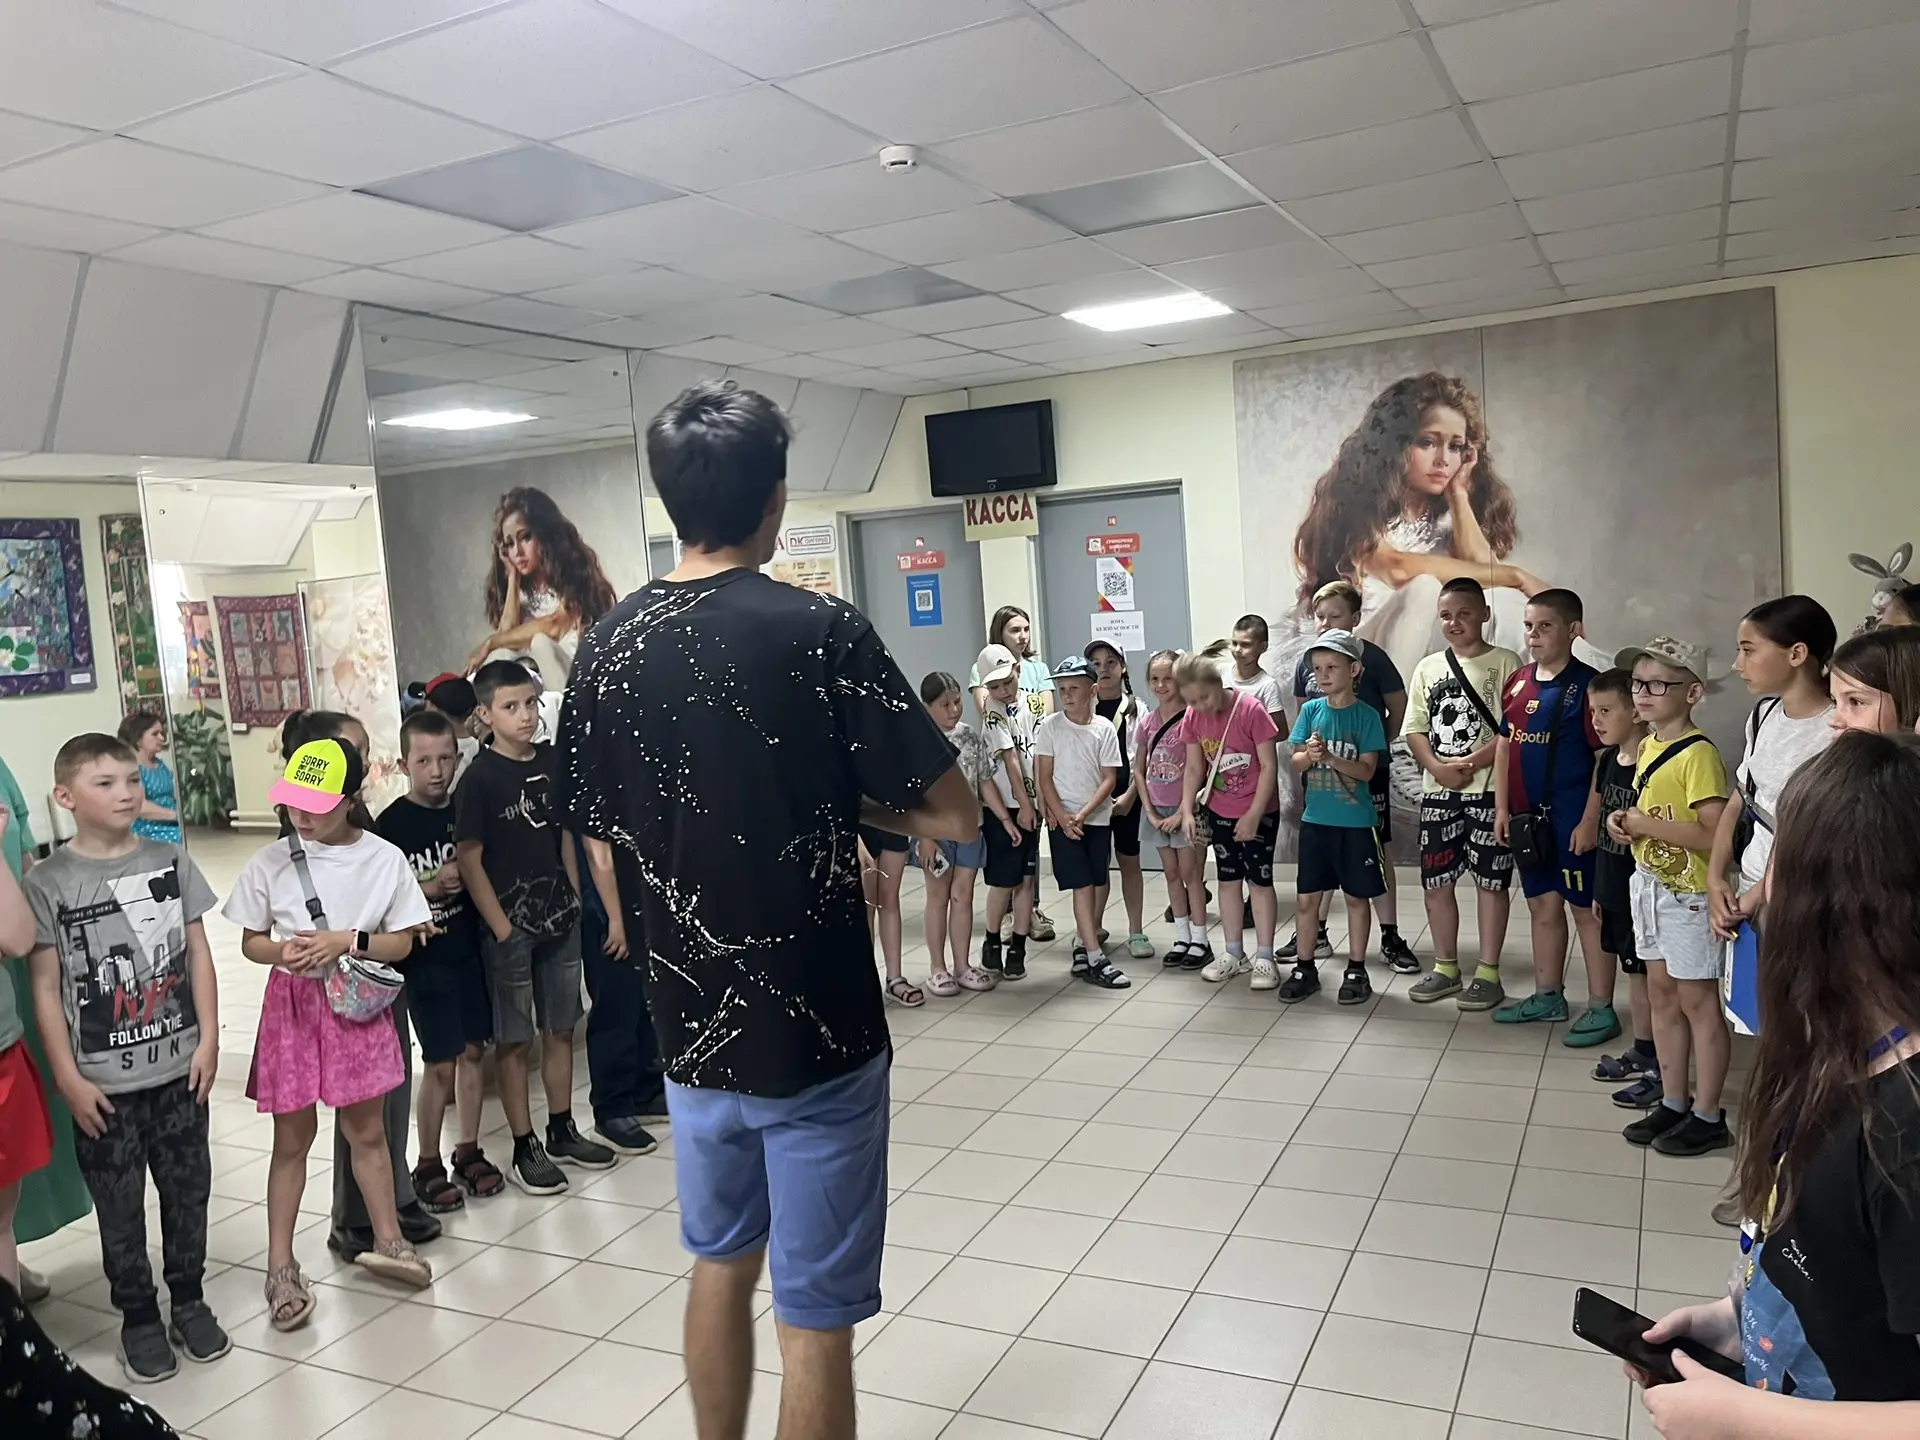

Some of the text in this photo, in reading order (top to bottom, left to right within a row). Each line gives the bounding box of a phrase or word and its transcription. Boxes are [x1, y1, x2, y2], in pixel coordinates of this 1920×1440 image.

[965, 492, 1034, 527] КАССА
[1514, 728, 1551, 744] Spotif
[301, 754, 330, 770] SORRY
[293, 769, 324, 787] SORRY
[408, 840, 457, 880] ENJO
[1562, 868, 1583, 891] 11
[108, 1012, 183, 1047] FOLLOW THE
[121, 1036, 180, 1070] SUN
